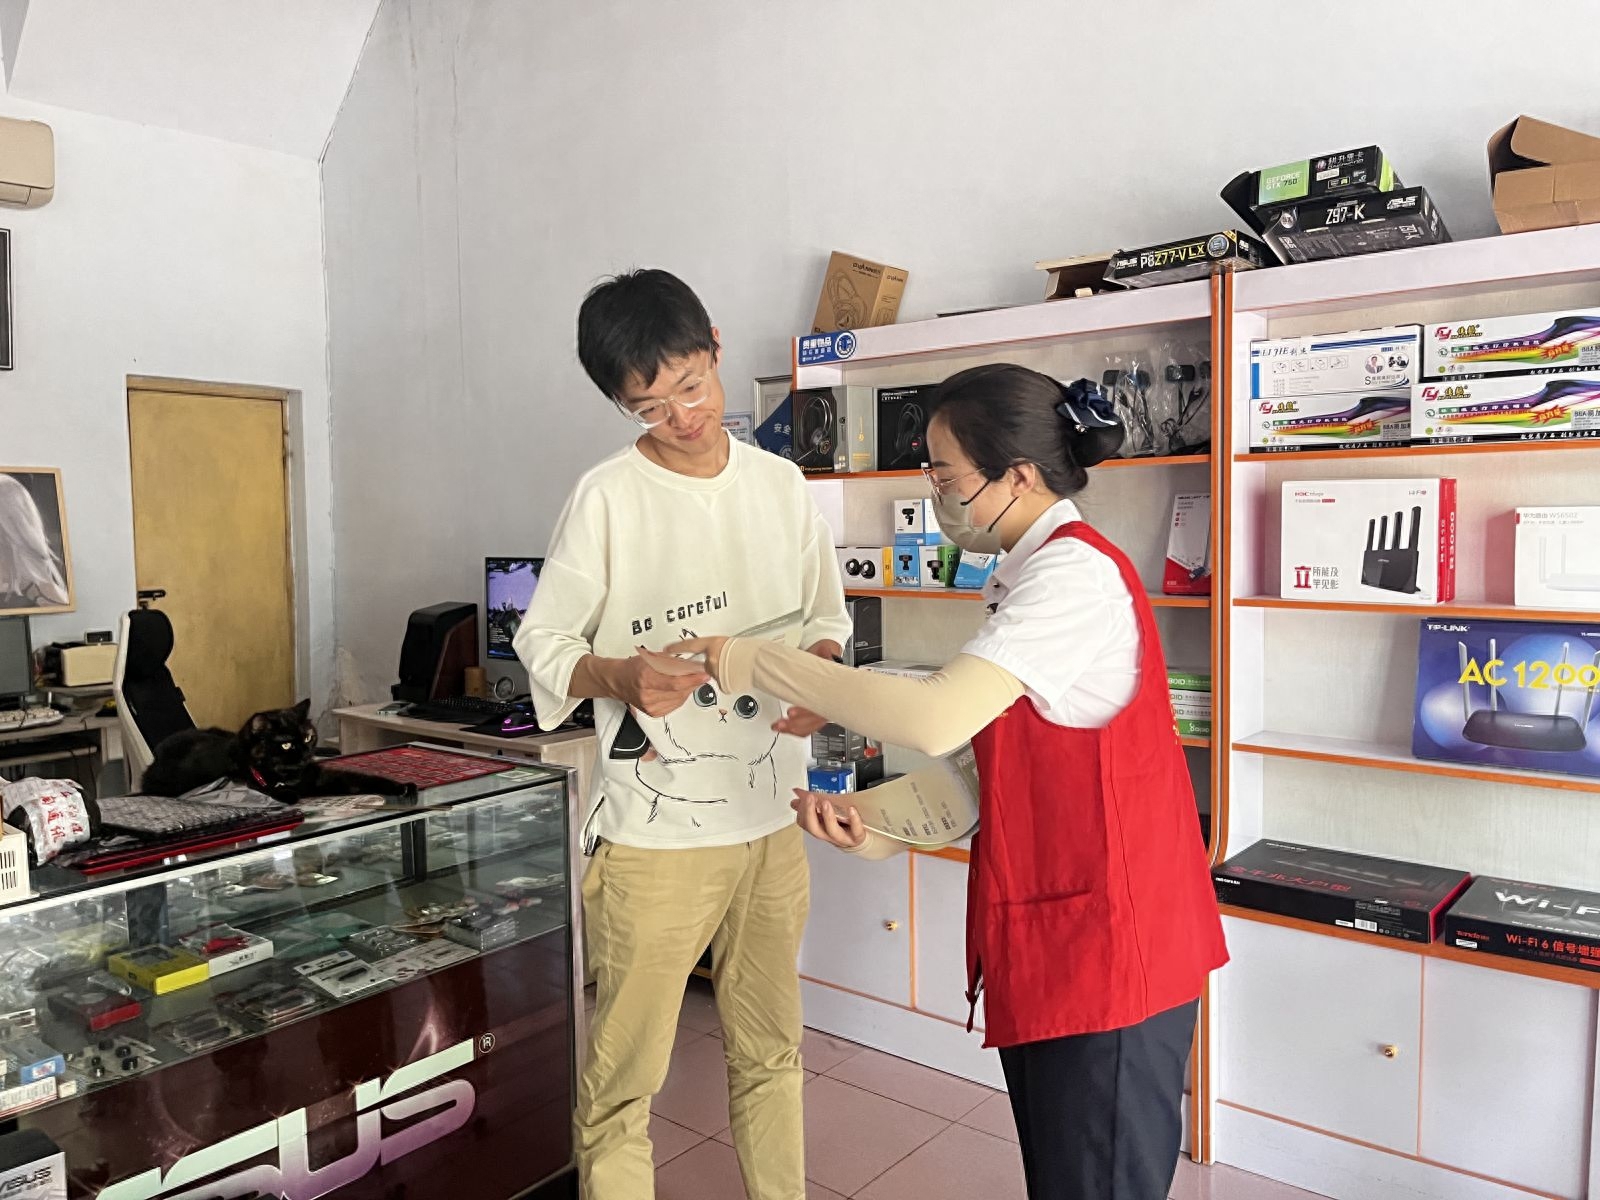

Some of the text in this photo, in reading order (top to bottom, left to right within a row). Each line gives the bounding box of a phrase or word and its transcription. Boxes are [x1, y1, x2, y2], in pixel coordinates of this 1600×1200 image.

[1266, 178, 1298, 190] GTX 750
[1386, 195, 1418, 207] ASUS
[1325, 203, 1365, 225] Z97-K
[1140, 247, 1186, 269] P8Z77-V
[773, 423, 793, 435] 安全
[1312, 566, 1339, 577] 所能及
[1312, 578, 1339, 590] 竿见影
[631, 591, 728, 636] Be careful
[1427, 623, 1469, 632] TP-LINK
[1506, 933, 1538, 948] Wi-Fi
[1541, 939, 1549, 949] 6
[95, 1038, 476, 1200] SUS
